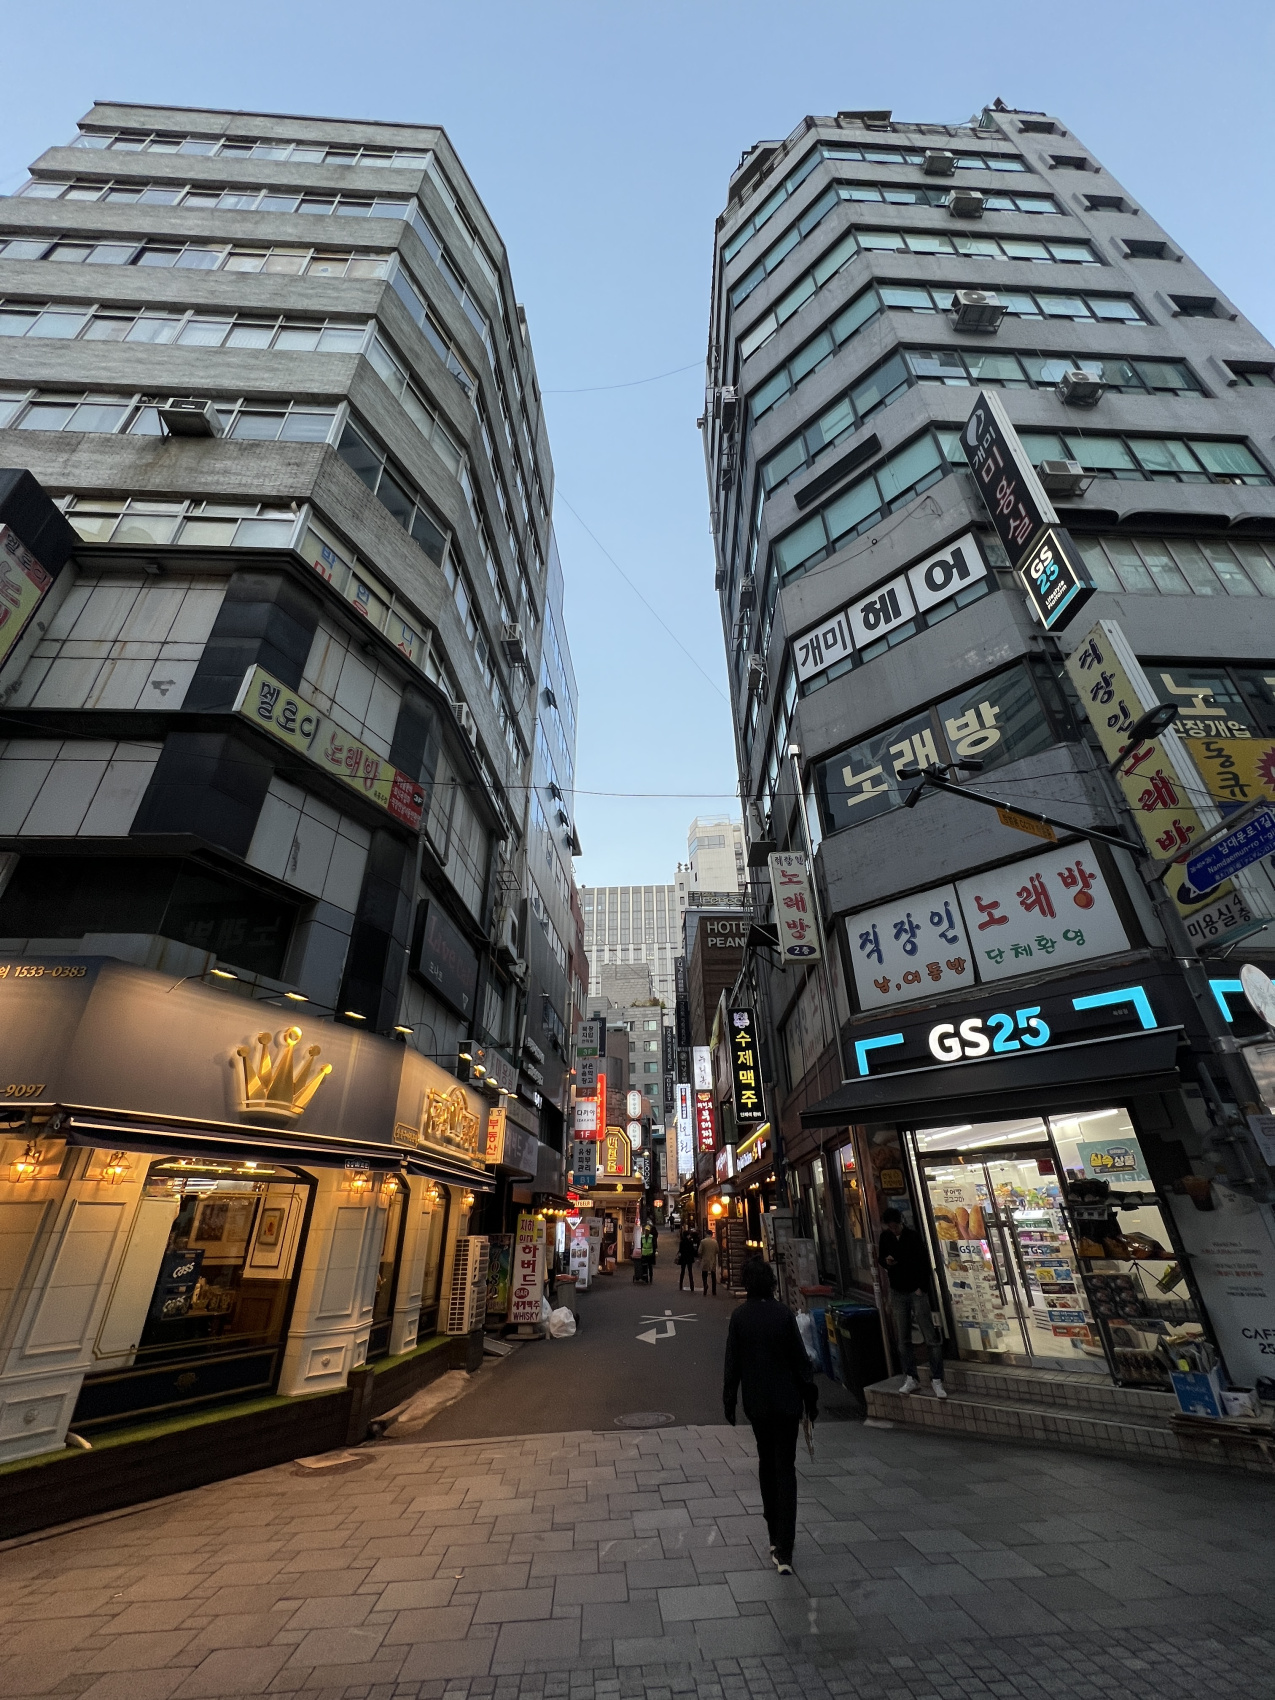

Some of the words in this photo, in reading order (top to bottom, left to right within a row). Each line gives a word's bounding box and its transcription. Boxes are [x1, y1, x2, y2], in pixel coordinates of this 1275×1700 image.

[972, 425, 996, 470] 개미
[981, 445, 1033, 546] 미용실
[1030, 545, 1053, 579] GS
[1037, 559, 1059, 595] 25
[798, 619, 848, 668] 개미
[860, 546, 971, 631] 헤어
[1045, 580, 1065, 605] Lifestyle
[1047, 584, 1067, 610] Platform
[1079, 638, 1135, 734] 직장인
[257, 680, 321, 751] 멜로디
[324, 730, 381, 792] 노래방
[842, 700, 1001, 807] 노래방
[1217, 814, 1273, 855] 남대문로1길
[1207, 839, 1260, 874] Namdaemun-ro
[779, 869, 811, 940] 노래방
[858, 900, 960, 965] 직장인
[974, 860, 1098, 932] 노래방
[1187, 904, 1238, 939] 미용실
[707, 921, 750, 934] HOTE
[708, 937, 747, 948] PEAN
[985, 928, 1087, 965] 단체환영
[14, 966, 87, 978] 1533-0383
[928, 1006, 1050, 1062] GS25
[735, 1030, 758, 1109] 수제맥주
[582, 1088, 592, 1096] 2F
[486, 1119, 498, 1156] 부동산
[701, 1109, 714, 1146] 부대찌개
[577, 1164, 591, 1172] 관리
[578, 1156, 591, 1164] 피부
[520, 1219, 535, 1232] 지하
[520, 1245, 539, 1286] 하버드
[959, 1245, 981, 1254] GS25
[172, 1262, 196, 1279] Cass
[513, 1312, 539, 1321] WHISKY
[1242, 1328, 1275, 1341] CAF
